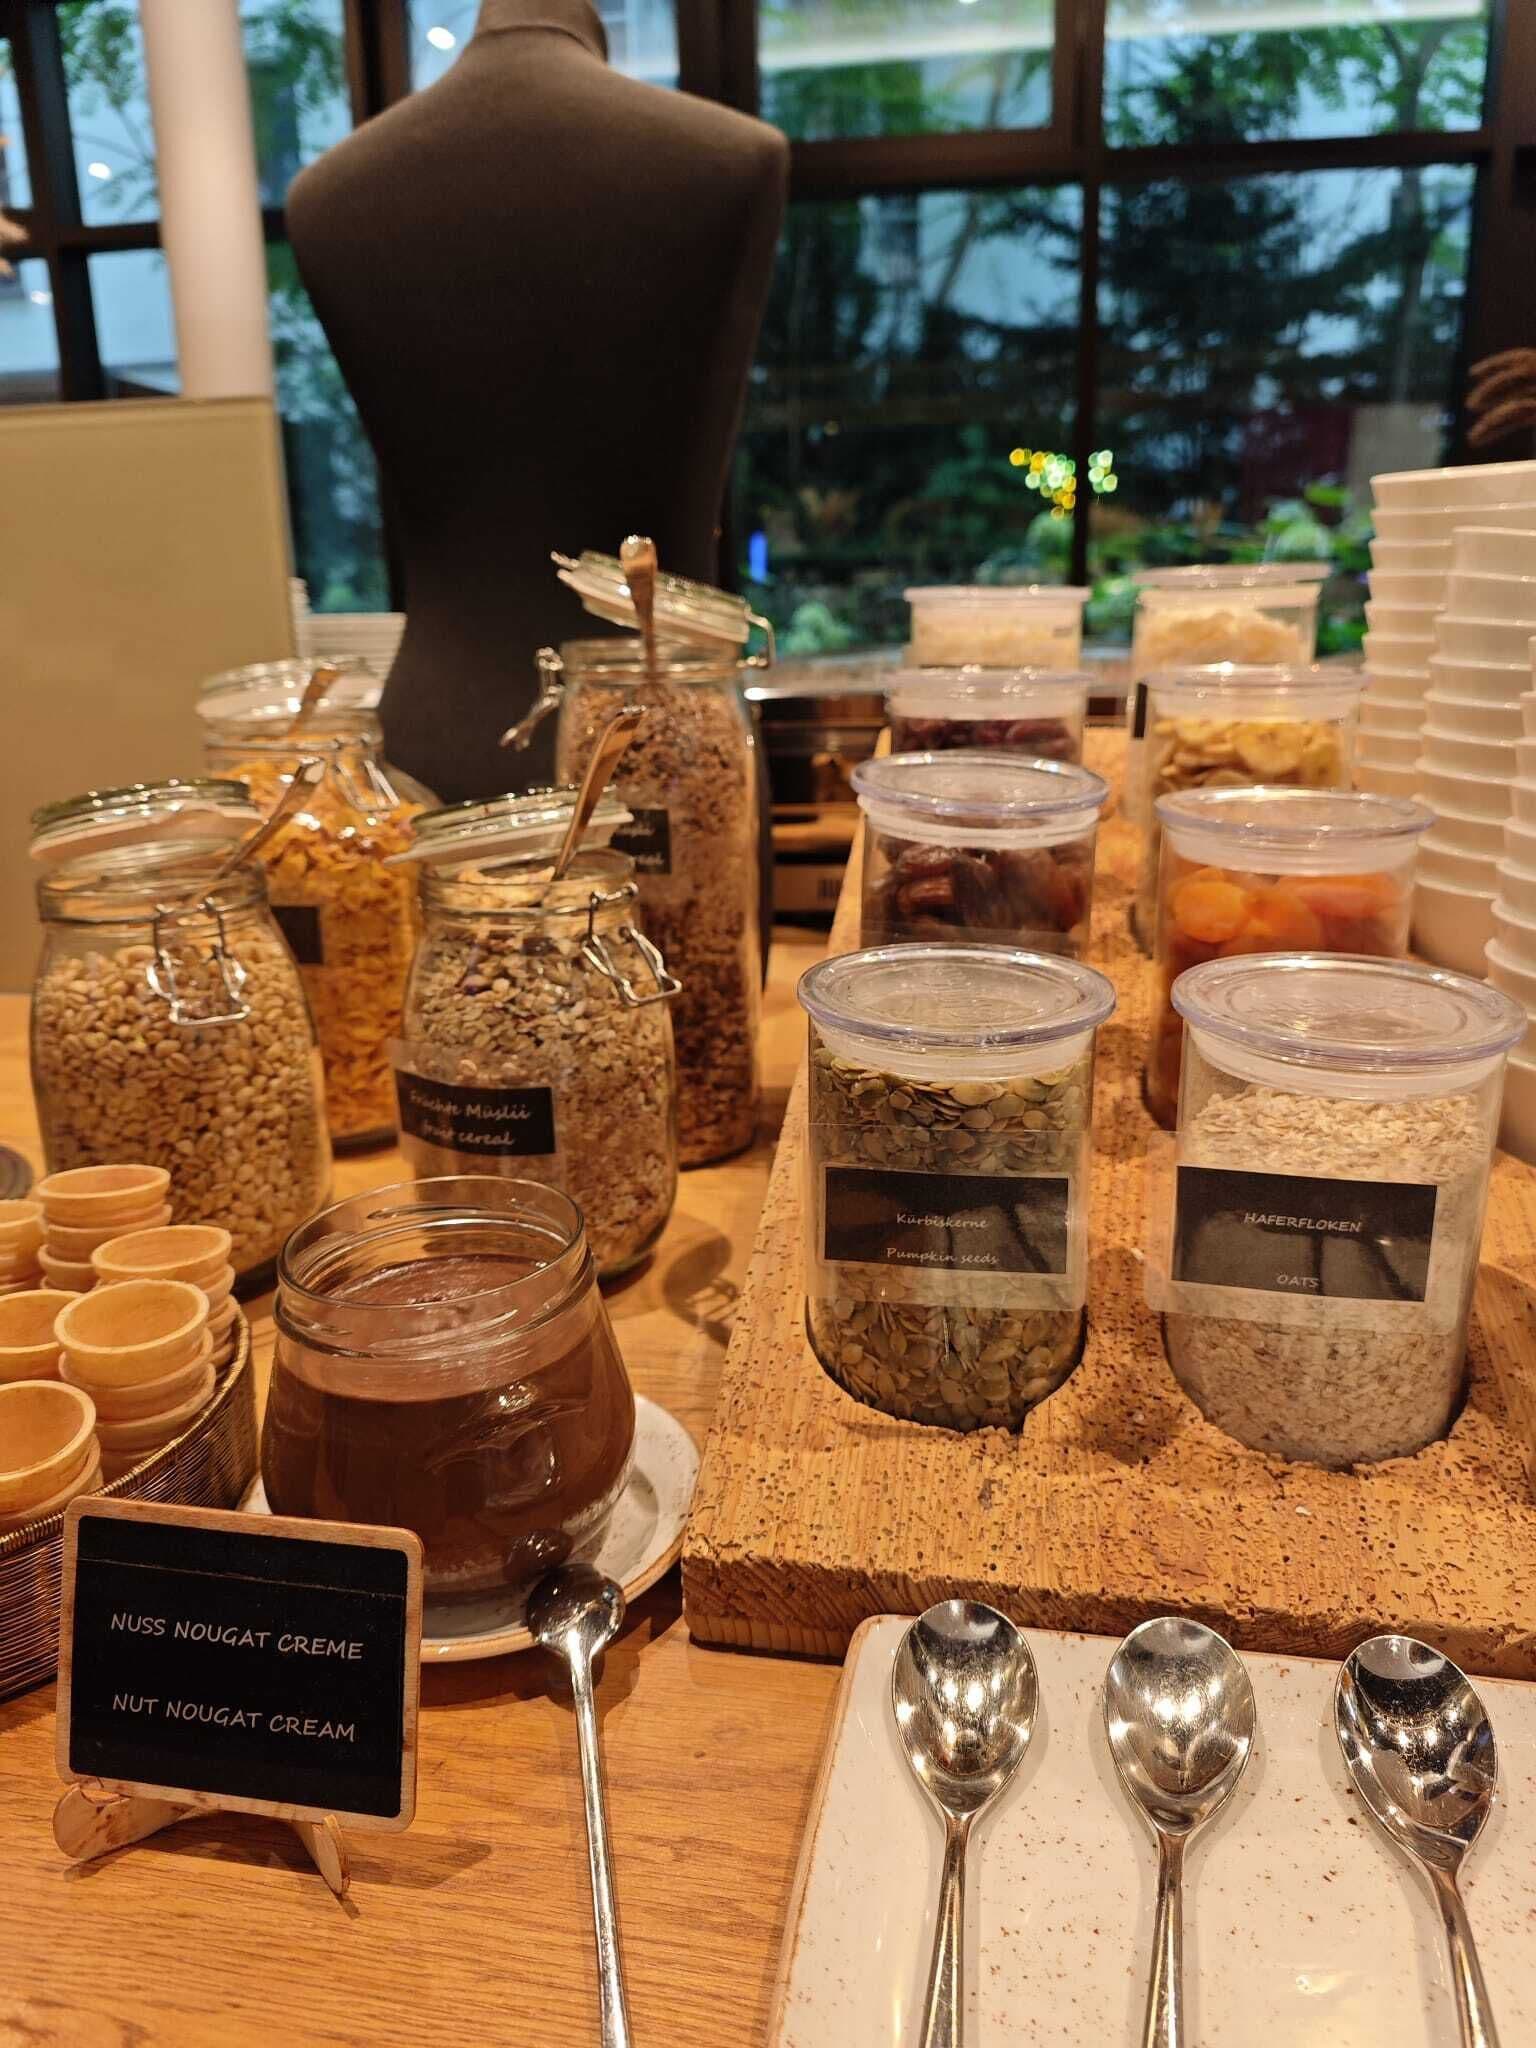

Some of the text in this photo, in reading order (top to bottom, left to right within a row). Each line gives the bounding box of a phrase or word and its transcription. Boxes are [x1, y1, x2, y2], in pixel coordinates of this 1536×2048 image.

[458, 1131, 515, 1146] cereal
[896, 1213, 988, 1229] Kürbiskerne
[1243, 1212, 1363, 1233] HAFERFLOKEN
[886, 1247, 1000, 1265] Pumpkin seeds
[111, 1612, 364, 1661] NUSS NOUGAT CREME
[112, 1693, 356, 1743] NUT NOUGAT CREAM
